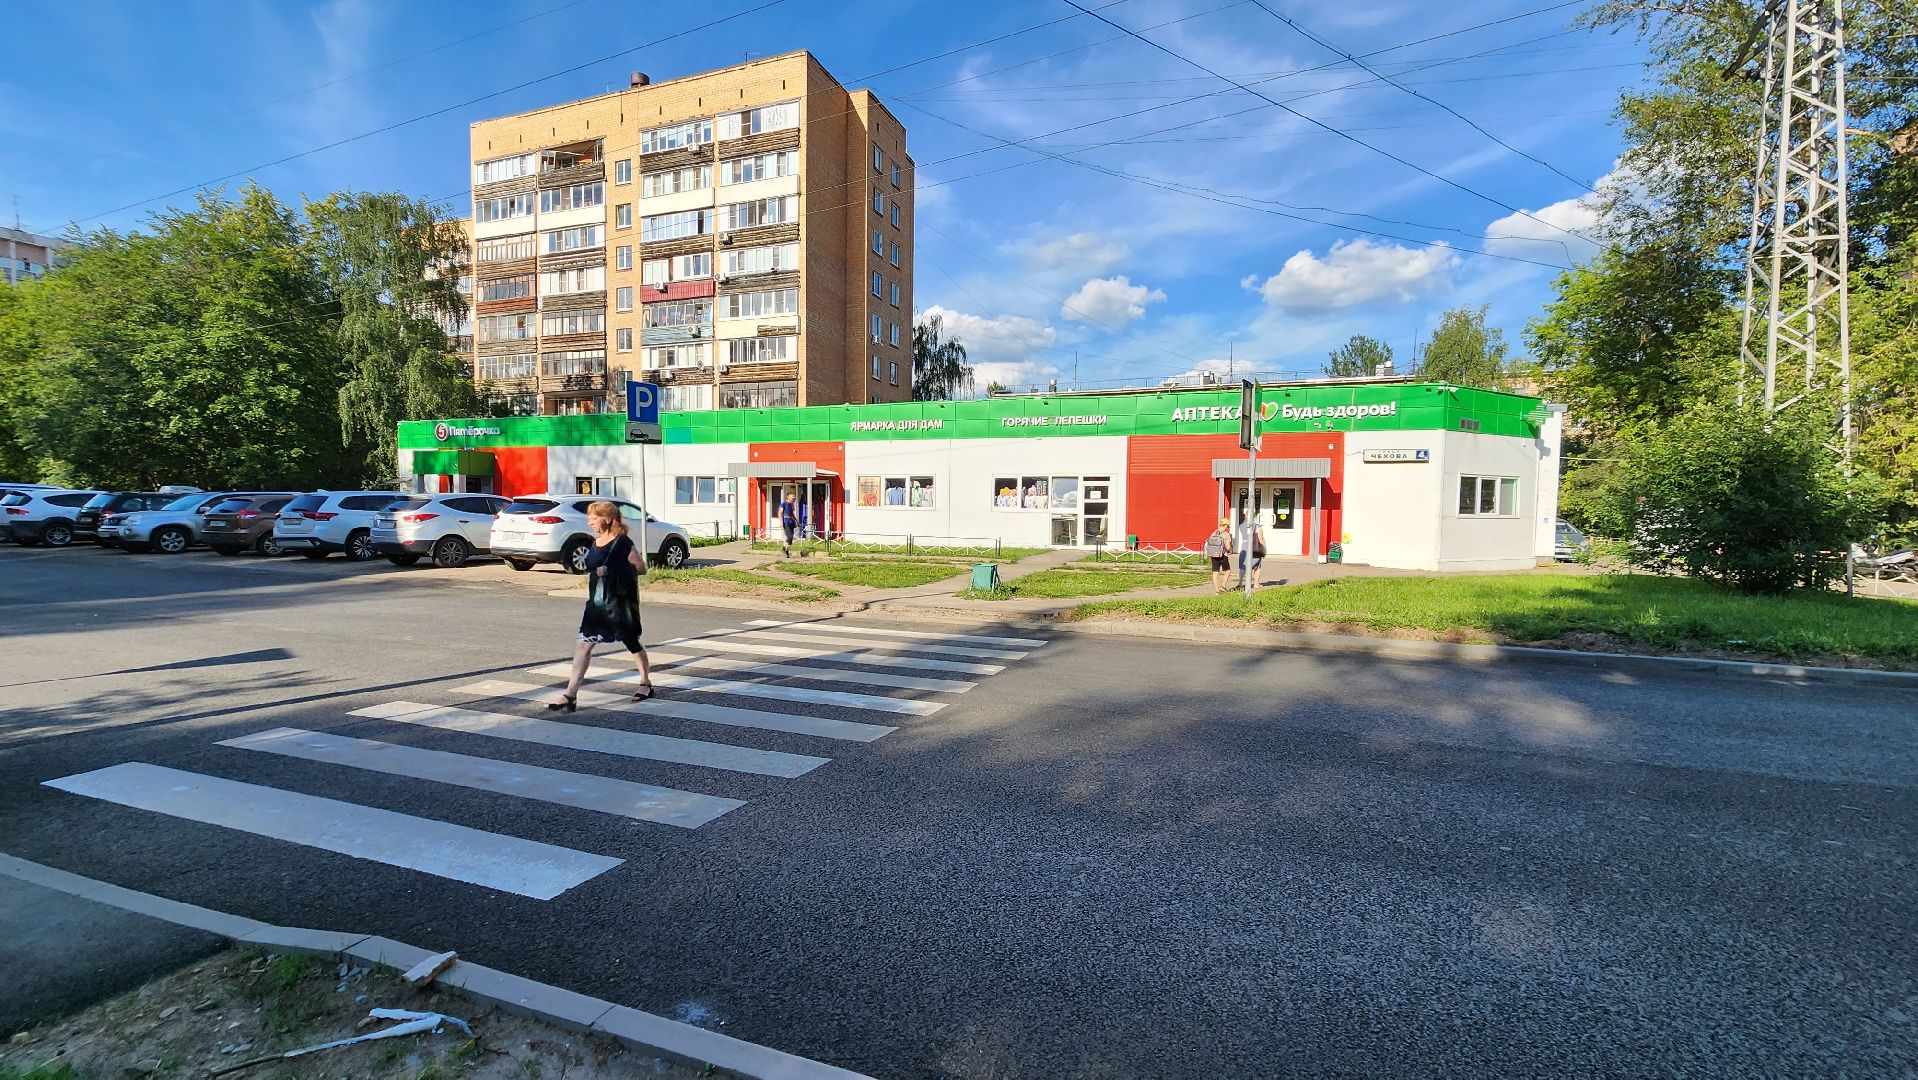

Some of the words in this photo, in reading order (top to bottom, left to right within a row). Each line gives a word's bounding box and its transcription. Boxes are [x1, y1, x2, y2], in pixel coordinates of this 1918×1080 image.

[635, 386, 653, 418] P
[1282, 404, 1322, 421] Будь
[1326, 401, 1396, 420] здоров!
[851, 421, 896, 431] ЯРМАРКА
[898, 420, 918, 431] ДЛЯ
[921, 419, 944, 430] ДАМ
[1001, 417, 1049, 427] ГОРЯЧИЕ
[1055, 415, 1107, 426] ЛЕПЕШКИ
[449, 426, 500, 437] Пятёрочка
